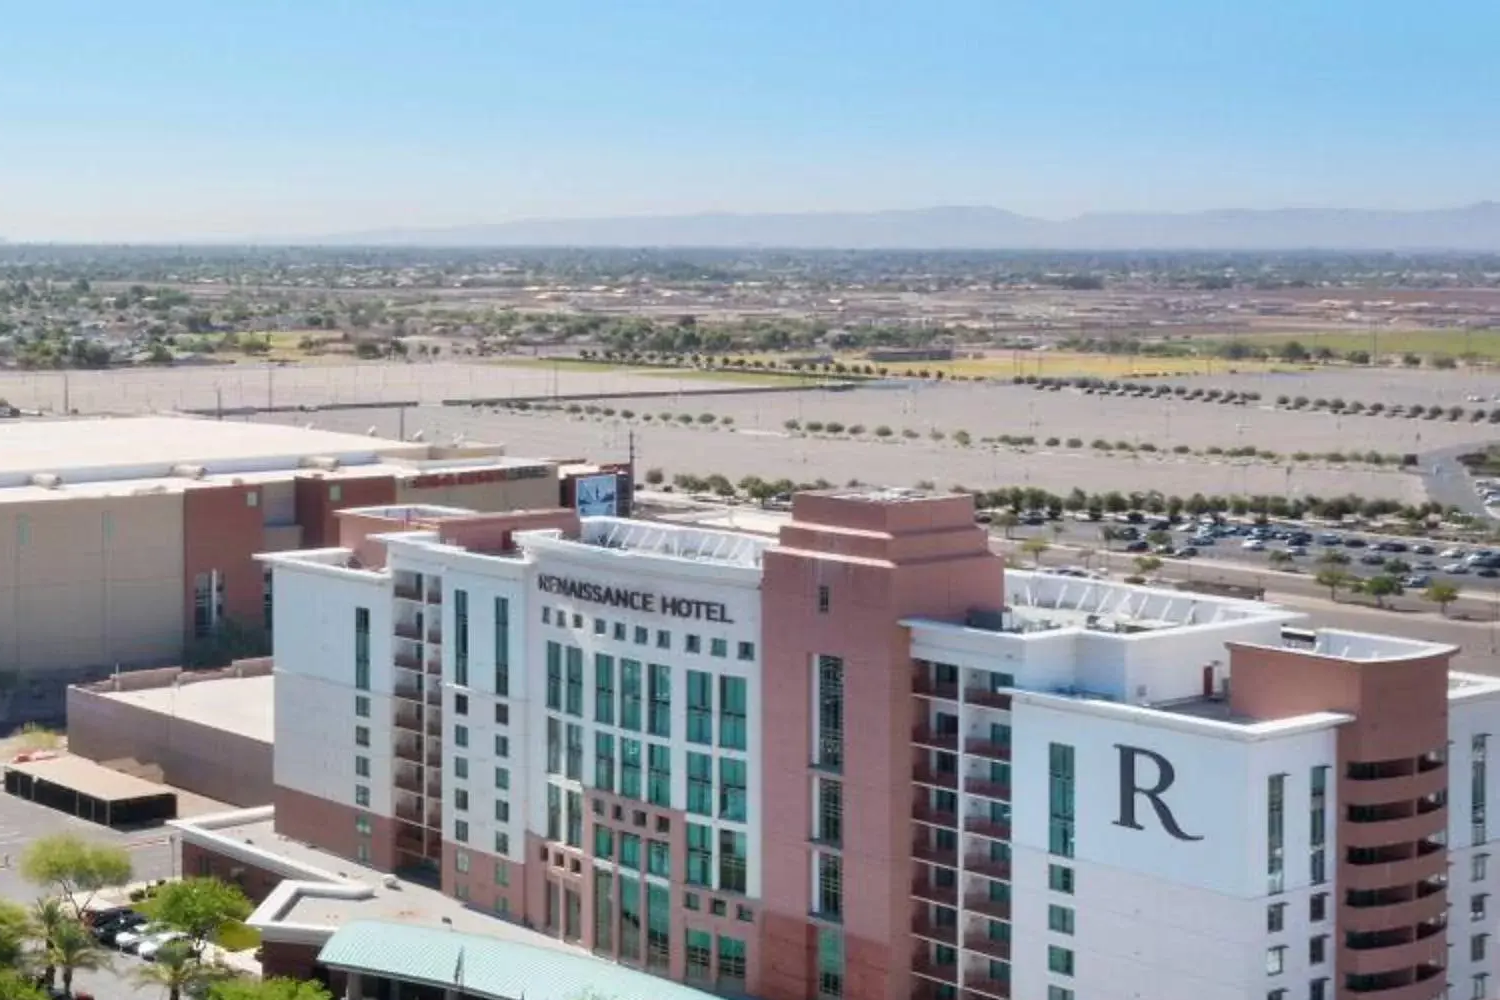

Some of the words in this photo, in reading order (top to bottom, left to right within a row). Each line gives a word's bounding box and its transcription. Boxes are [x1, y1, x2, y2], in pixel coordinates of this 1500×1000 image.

[538, 573, 655, 612] RENAISSANCE
[661, 595, 734, 624] HOTEL
[1112, 743, 1204, 841] R
